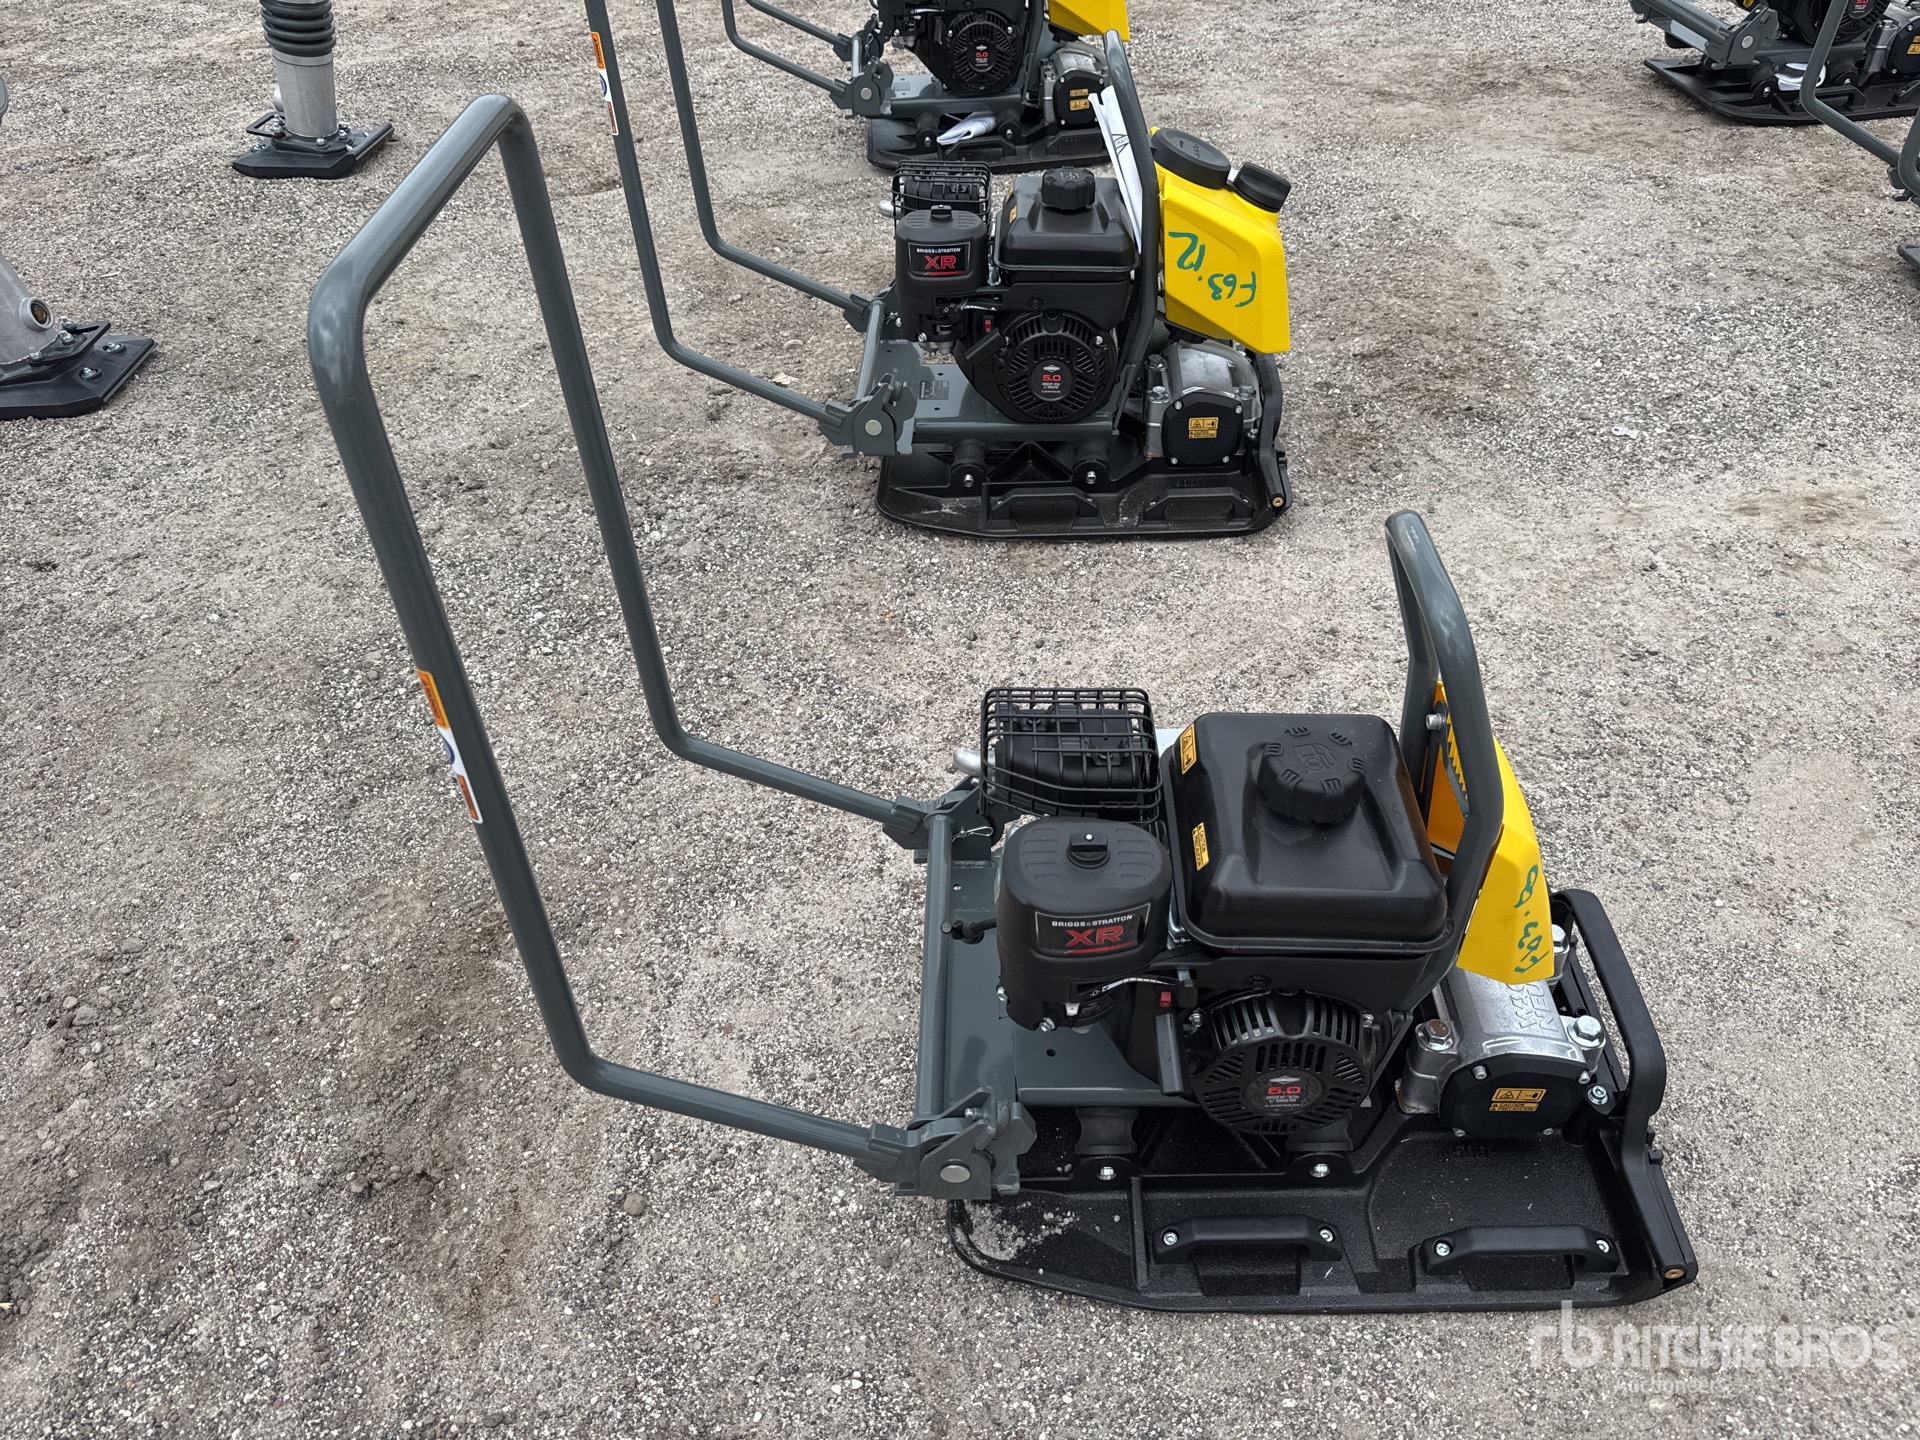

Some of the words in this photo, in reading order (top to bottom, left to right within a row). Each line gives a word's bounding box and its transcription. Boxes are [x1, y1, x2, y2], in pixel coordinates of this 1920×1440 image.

[924, 255, 957, 269] XR
[1042, 374, 1062, 382] 5.0
[1064, 925, 1124, 947] XR
[1267, 1086, 1302, 1095] 5.0
